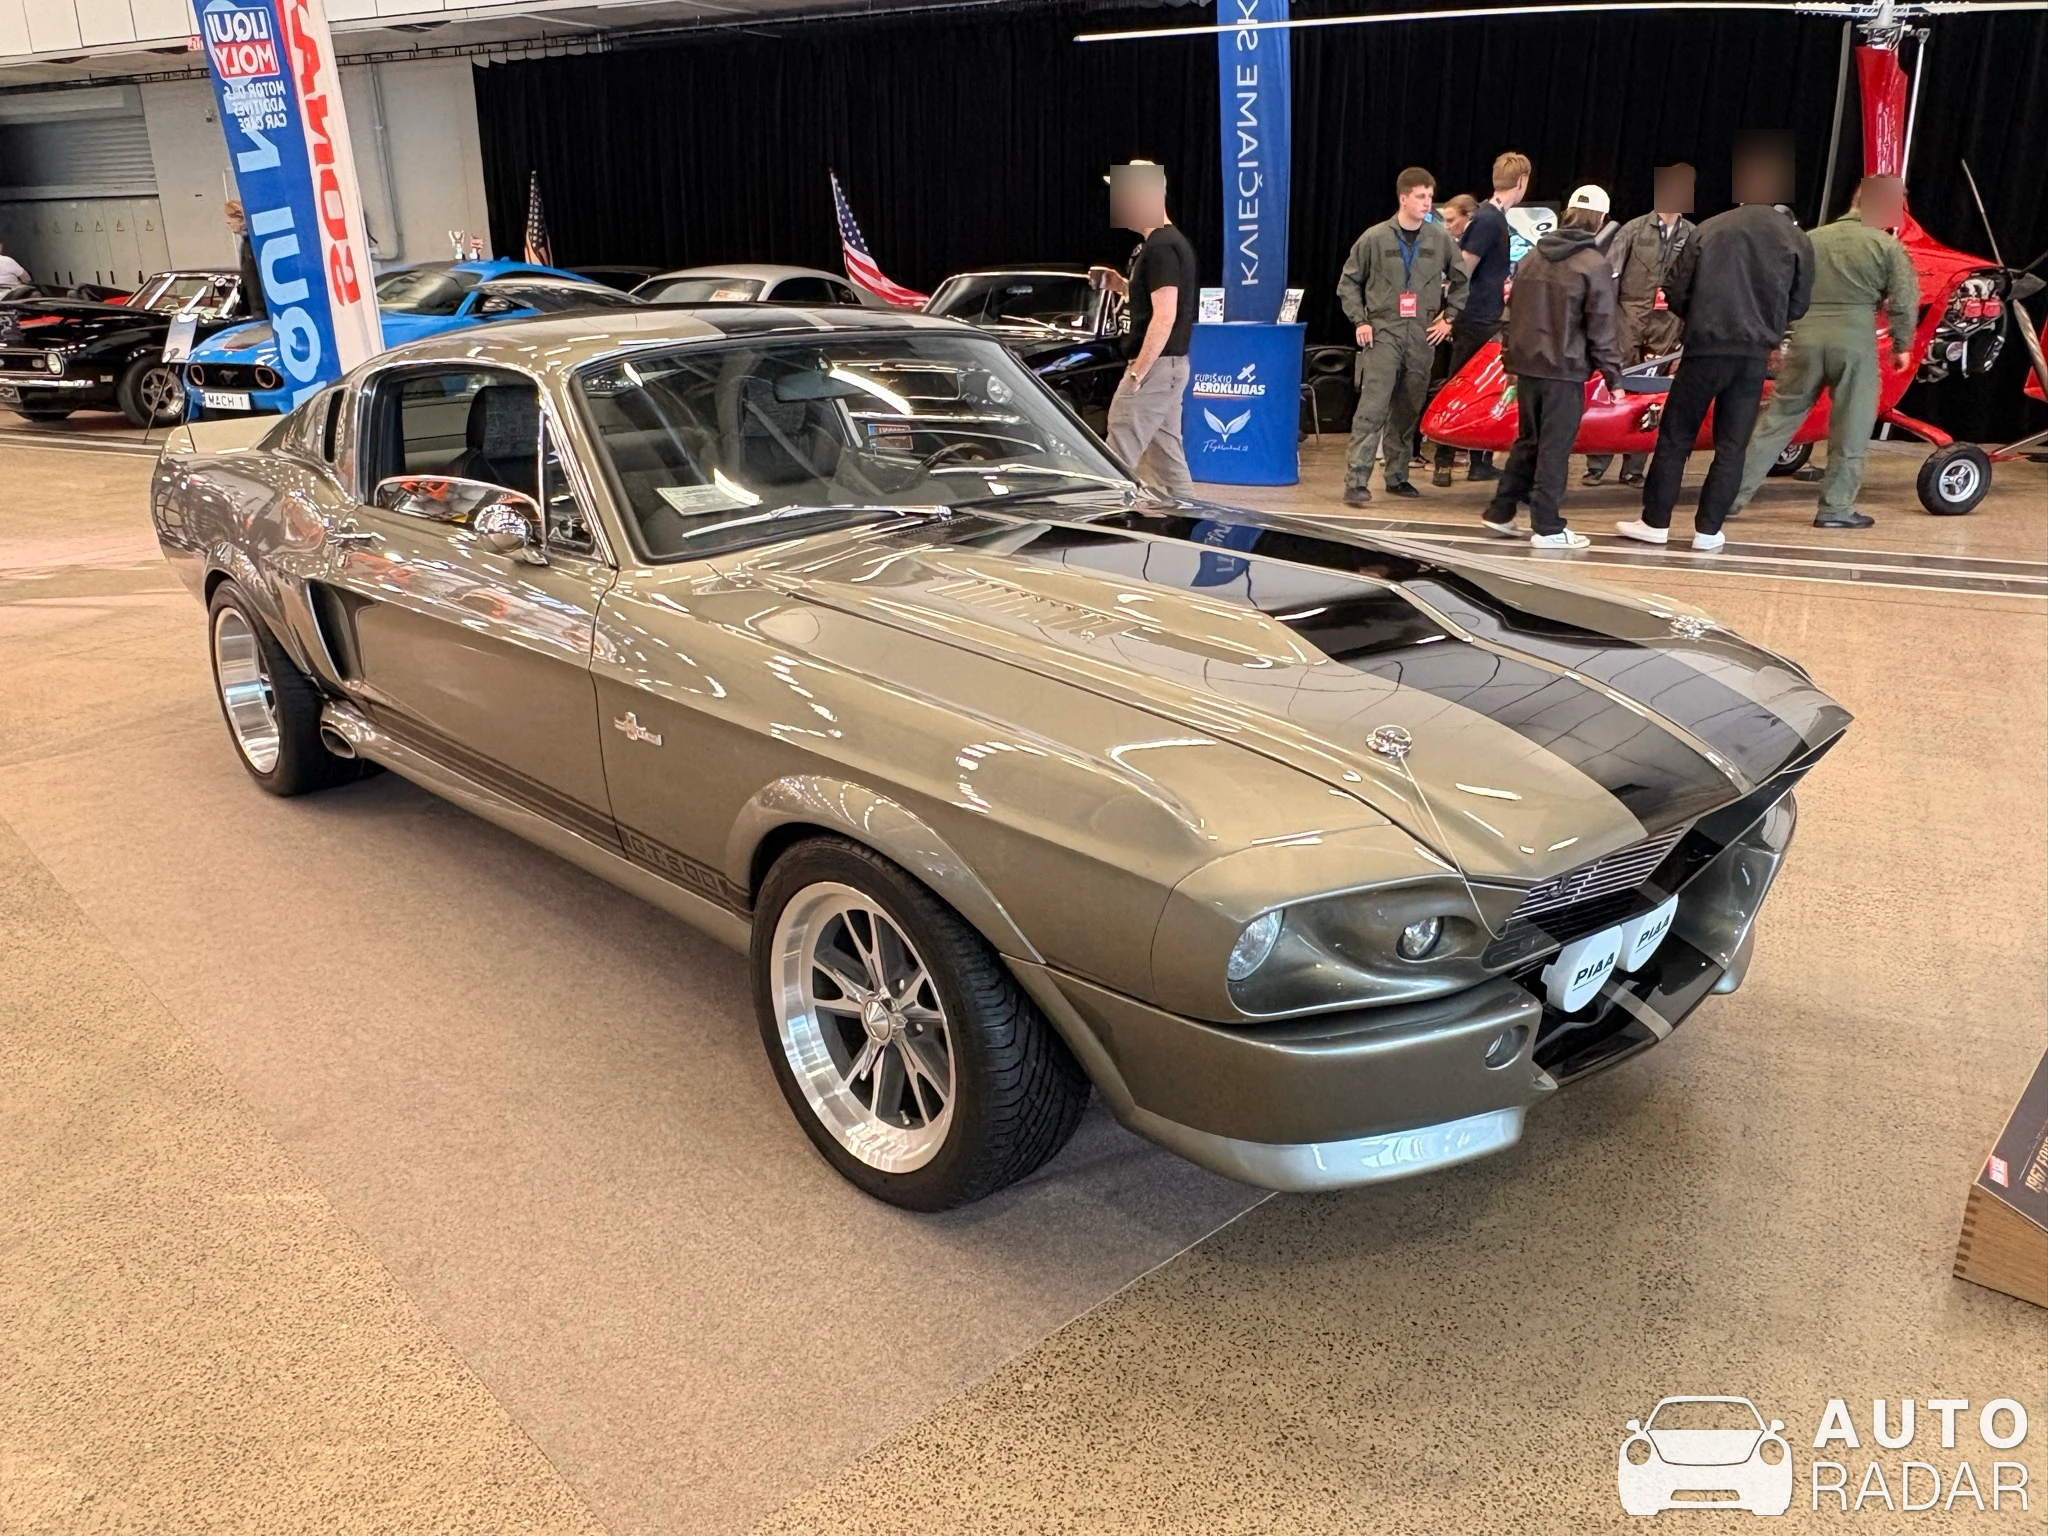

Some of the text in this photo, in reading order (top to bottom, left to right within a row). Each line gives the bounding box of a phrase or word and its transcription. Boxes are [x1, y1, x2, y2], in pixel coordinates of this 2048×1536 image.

[1193, 382, 1266, 396] AEROKLUBAS
[208, 395, 244, 408] MACH 1
[1637, 914, 1671, 948] PIAA
[1573, 951, 1615, 986] PIAA
